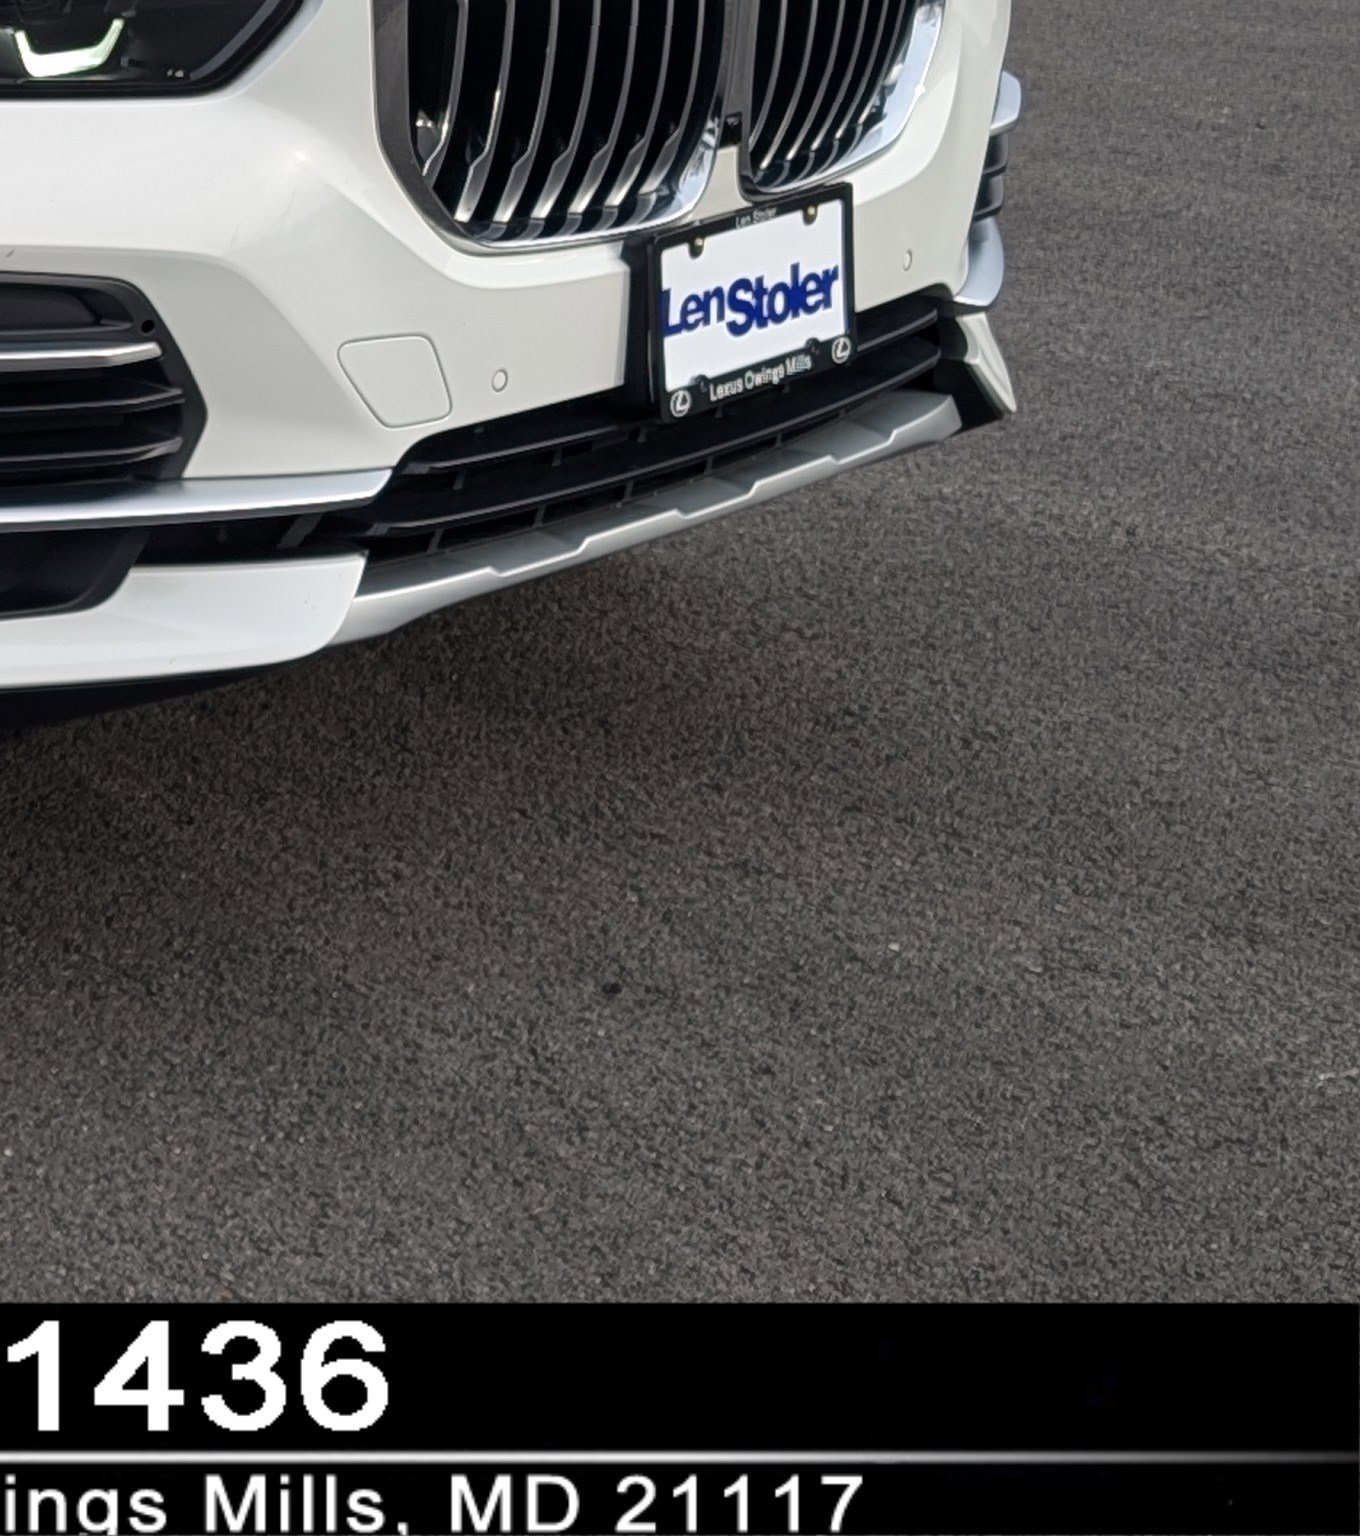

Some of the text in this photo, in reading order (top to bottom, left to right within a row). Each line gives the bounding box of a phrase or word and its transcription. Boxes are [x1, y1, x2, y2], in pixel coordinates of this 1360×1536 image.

[660, 262, 839, 337] LenStoler
[709, 353, 813, 402] Lexus Owings Mills
